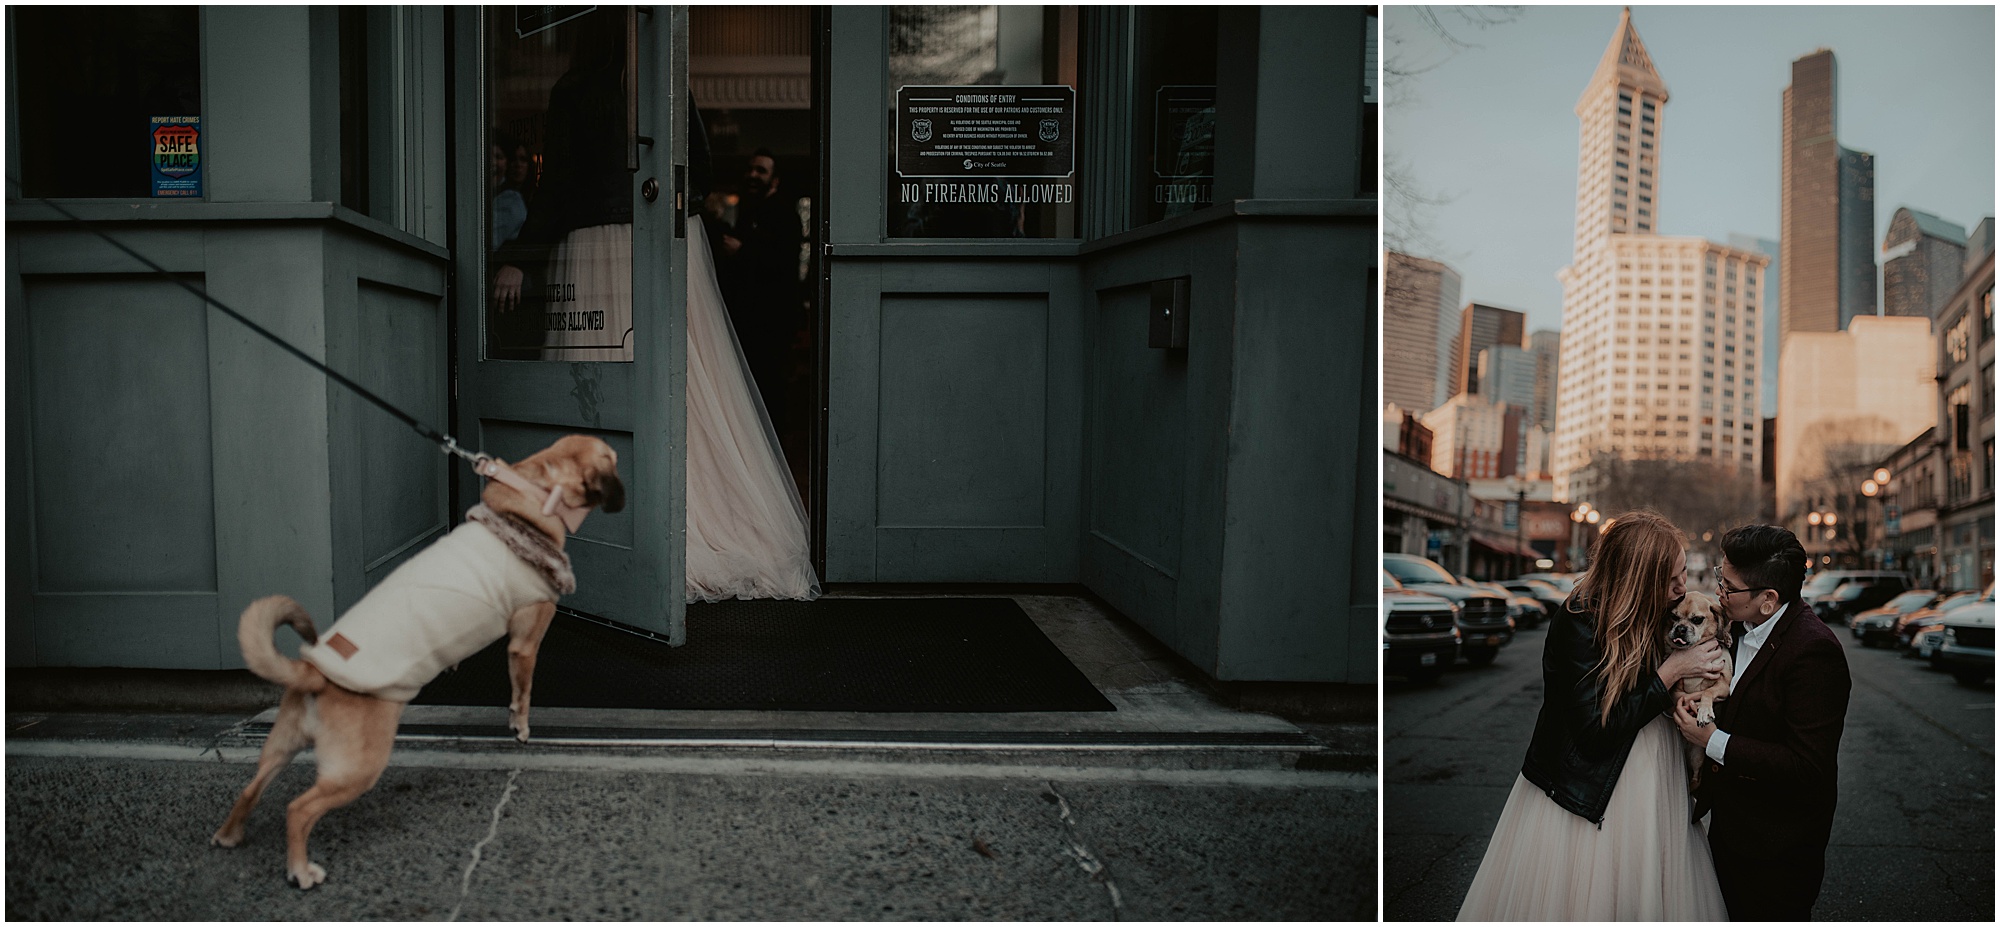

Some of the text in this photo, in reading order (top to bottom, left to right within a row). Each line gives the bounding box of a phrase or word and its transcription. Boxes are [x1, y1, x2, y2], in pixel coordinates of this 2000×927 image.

[955, 94, 1016, 103] CONDITIONS OF ENTRY
[160, 136, 192, 152] SAFE
[160, 154, 192, 167] PLACE
[901, 183, 1073, 203] NO FIREARMS ALLOWED
[562, 283, 576, 302] 101
[567, 310, 605, 331] ALLOWED
